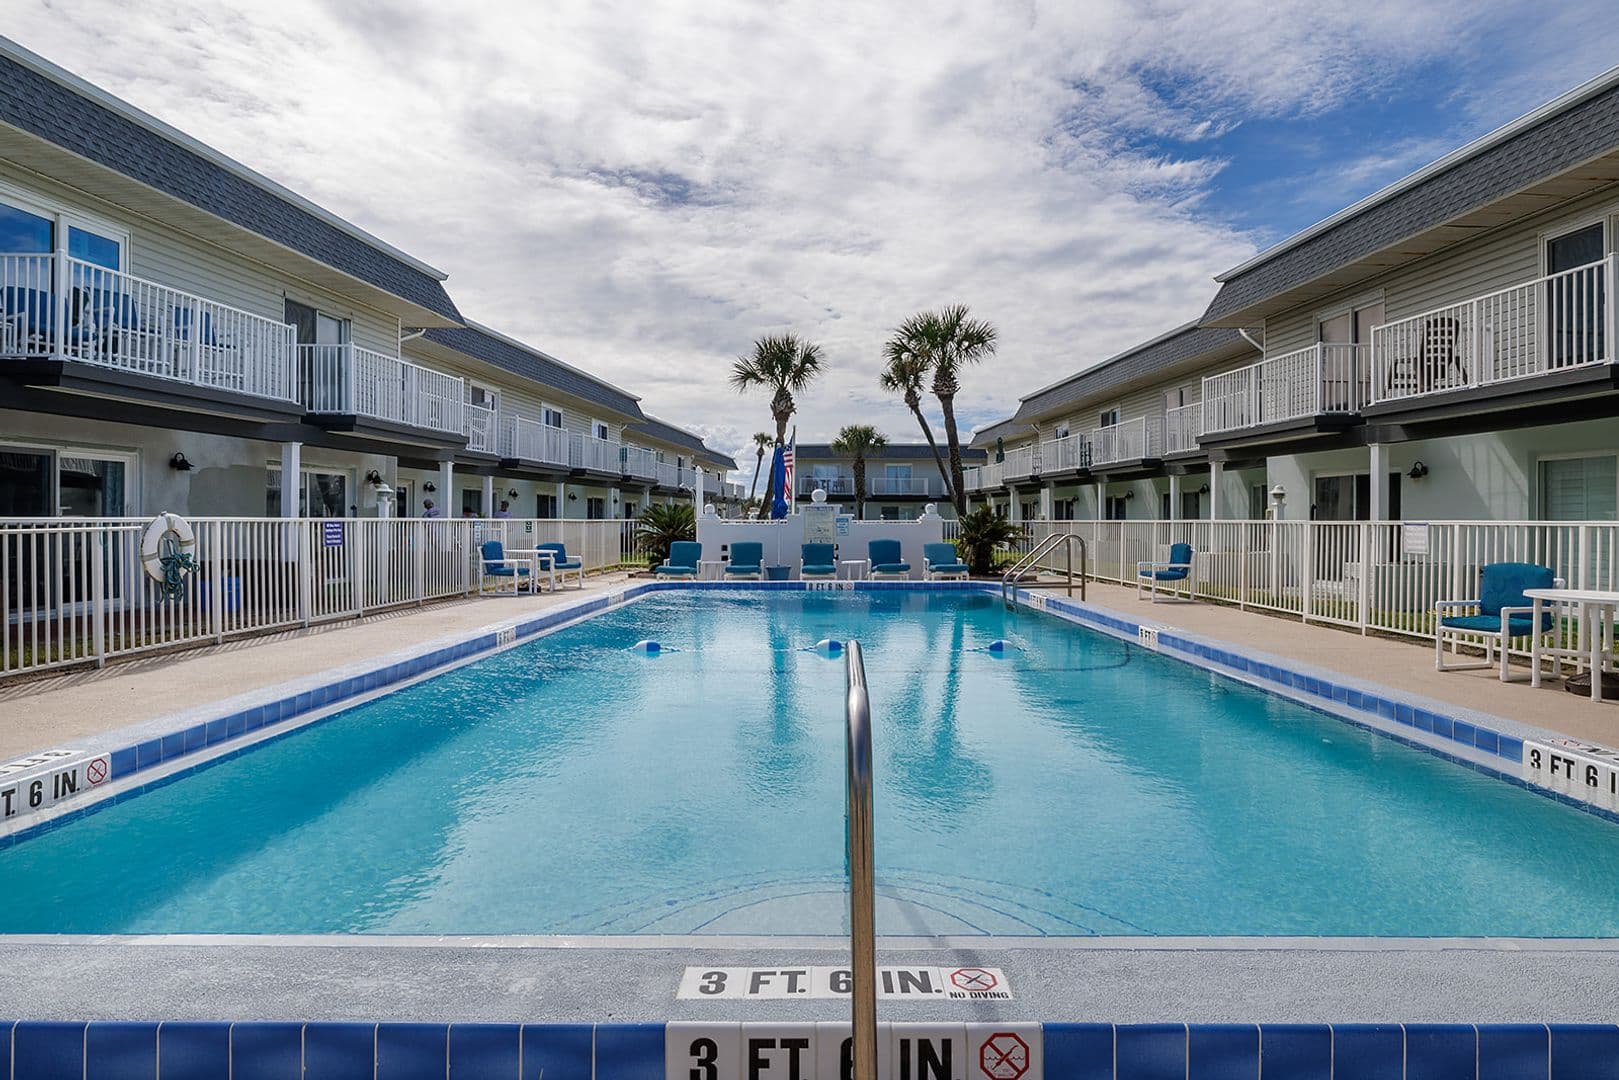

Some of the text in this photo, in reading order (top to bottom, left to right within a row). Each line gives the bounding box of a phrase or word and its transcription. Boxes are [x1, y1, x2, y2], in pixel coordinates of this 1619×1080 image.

[1530, 749, 1541, 769] 3
[1585, 765, 1598, 787] 6
[29, 780, 43, 808] 6
[53, 769, 80, 799] IN.
[699, 970, 943, 995] 3 FT. 6 IN.
[949, 991, 1010, 999] NO DIVING
[689, 1037, 718, 1080] 3
[748, 1038, 809, 1080] FT
[900, 1038, 960, 1080] IN
